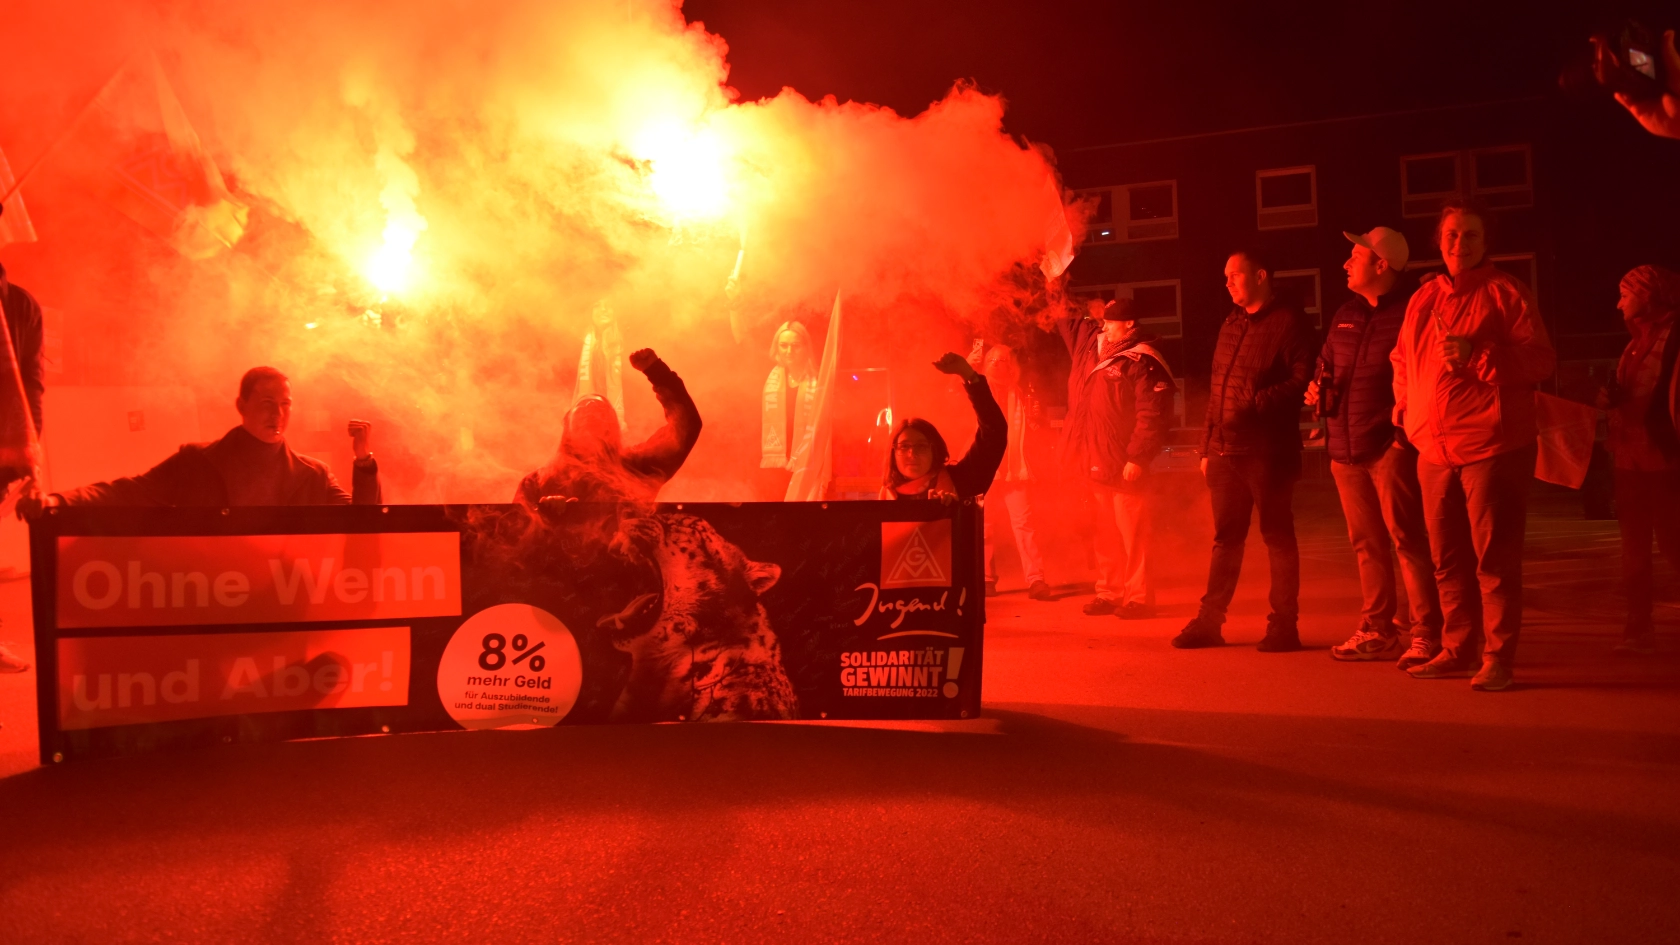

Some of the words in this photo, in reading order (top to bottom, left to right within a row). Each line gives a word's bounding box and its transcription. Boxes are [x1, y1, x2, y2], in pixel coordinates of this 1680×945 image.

[72, 559, 250, 611] Ohne
[268, 557, 447, 605] Wenn
[478, 633, 546, 672] 8%
[840, 646, 944, 667] SOLIDARITÄT
[72, 658, 200, 712] und
[219, 650, 395, 701] Aber!
[467, 675, 510, 687] mehr
[514, 675, 552, 689] Geld
[464, 691, 478, 699] für
[480, 692, 550, 703] Auszubildende
[843, 687, 914, 697] TARIFBEWEGUNG
[915, 688, 938, 697] 2022
[454, 702, 473, 710] und
[475, 702, 496, 711] dual
[497, 703, 559, 714] Studierende!
